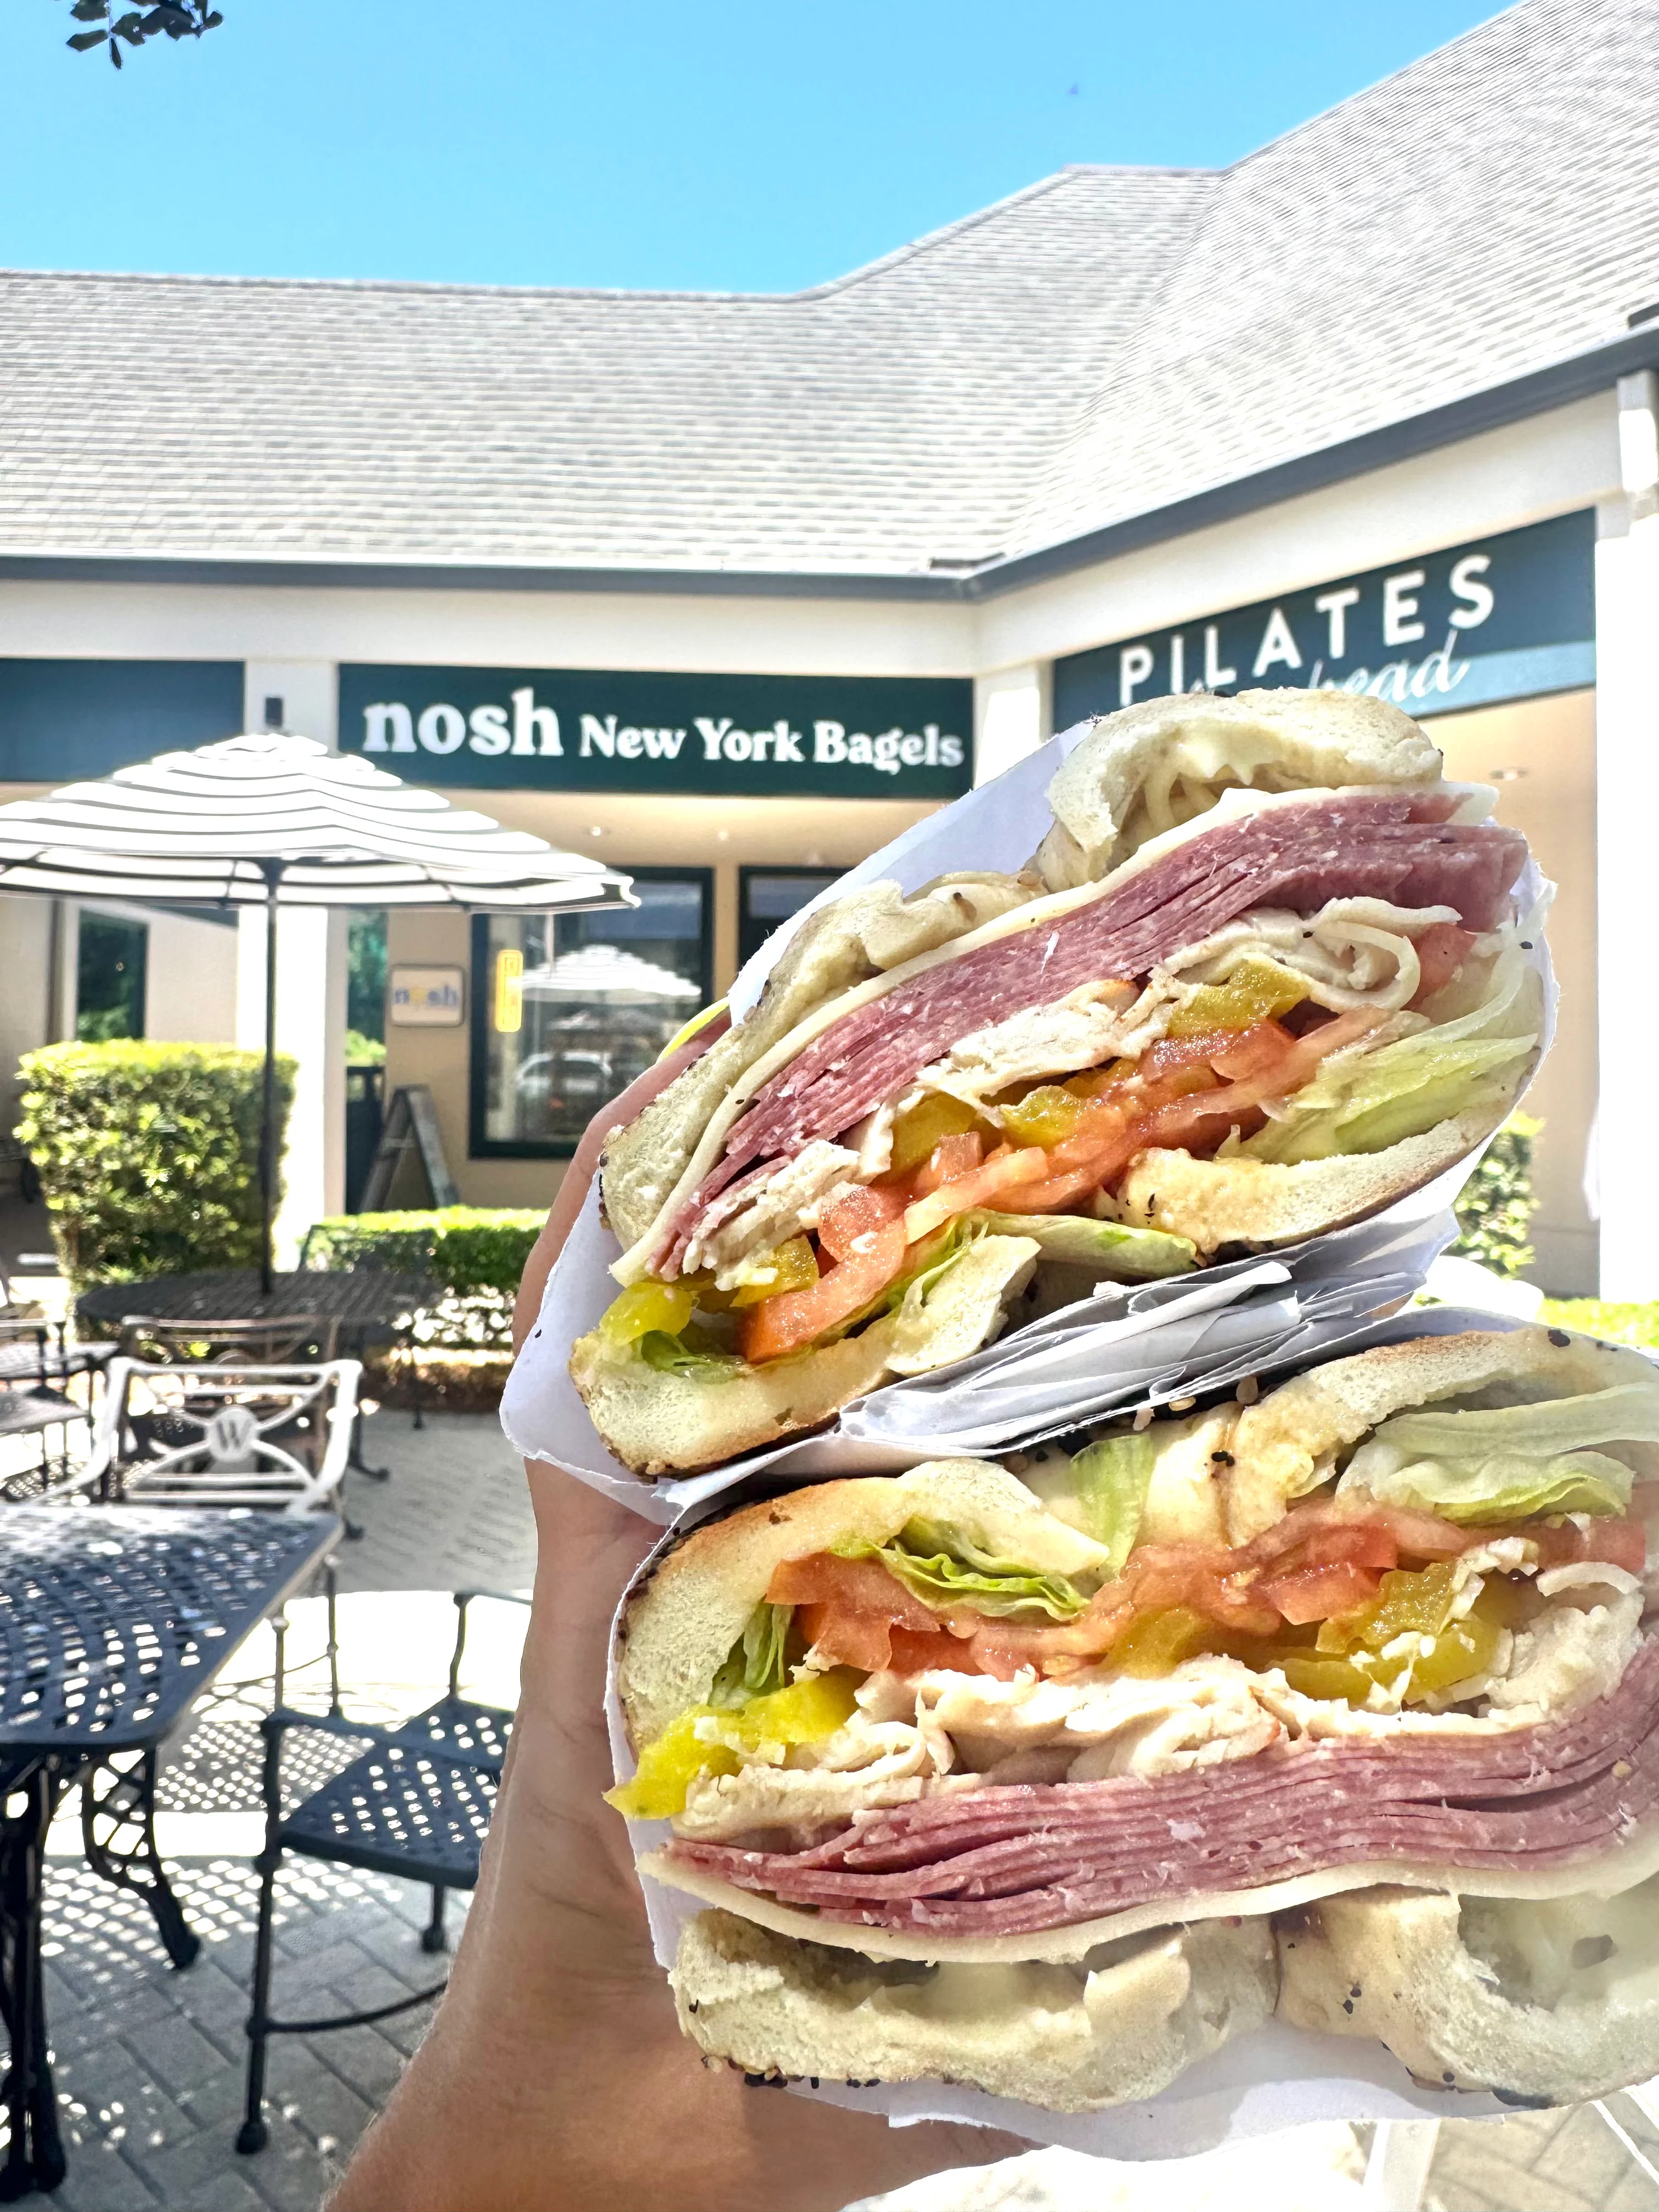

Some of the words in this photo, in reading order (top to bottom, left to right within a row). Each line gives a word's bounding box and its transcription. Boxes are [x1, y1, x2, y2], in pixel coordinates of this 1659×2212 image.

[1119, 554, 1493, 708] PILATES
[362, 686, 565, 756] nosh
[578, 714, 687, 759] New
[693, 716, 805, 762] York
[812, 720, 964, 775] Bagels
[216, 1419, 252, 1453] W
